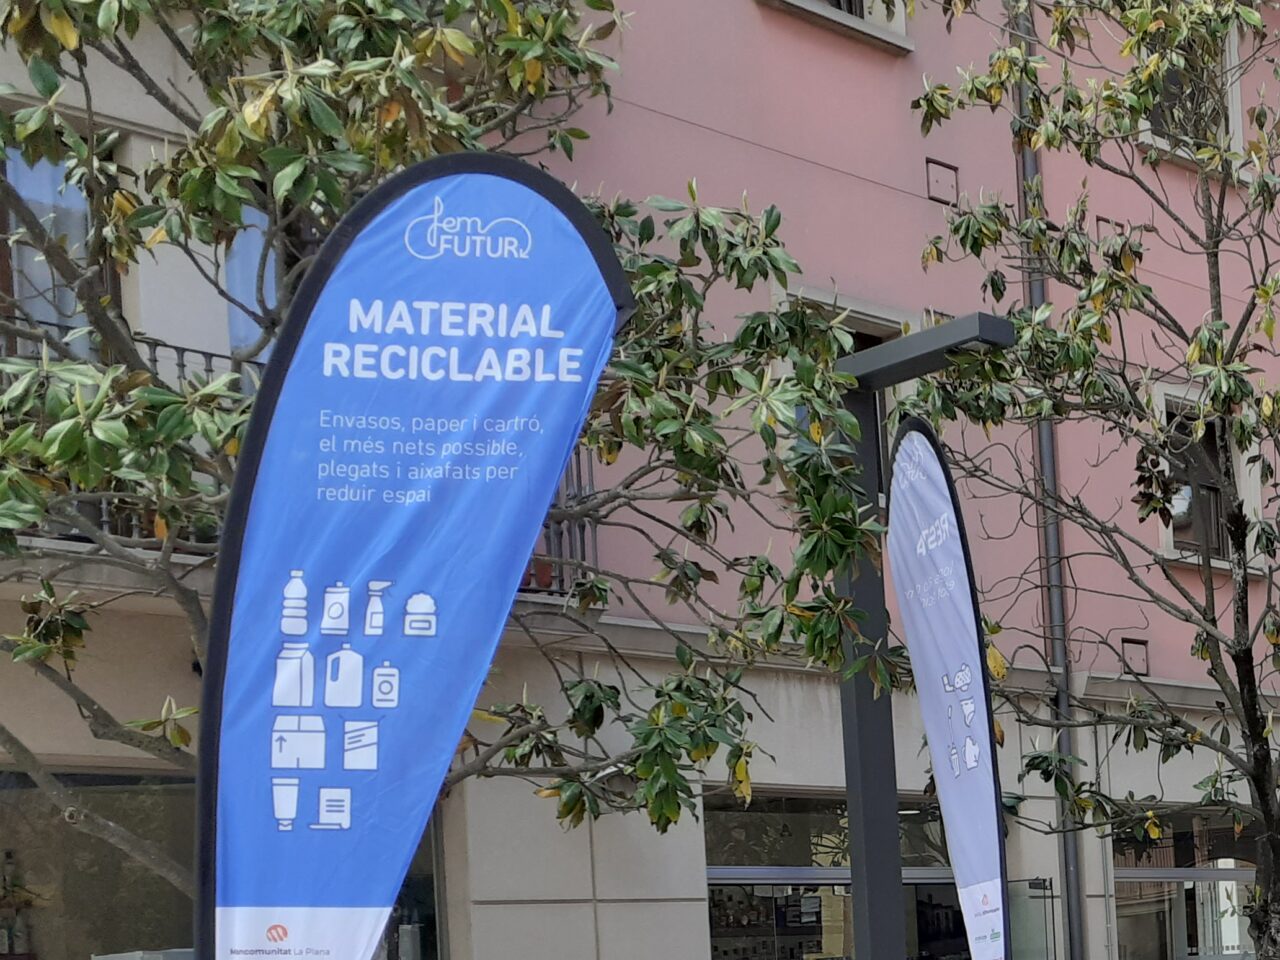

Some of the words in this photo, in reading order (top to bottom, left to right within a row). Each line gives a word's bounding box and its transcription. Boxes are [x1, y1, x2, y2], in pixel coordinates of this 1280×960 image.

[439, 235, 519, 259] FUTUR
[348, 298, 565, 338] MATERIAL
[322, 342, 584, 382] RECICLABLE
[319, 410, 405, 432] Envasos,
[411, 415, 467, 435] paper
[483, 413, 544, 435] cartró,
[319, 437, 336, 453] el
[343, 436, 385, 454] més
[392, 437, 436, 456] nets
[441, 438, 525, 460] possible,
[317, 460, 390, 482] plegats
[407, 462, 481, 480] aixafats
[486, 464, 518, 483] per
[317, 484, 376, 502] reduir
[382, 486, 432, 506] espai
